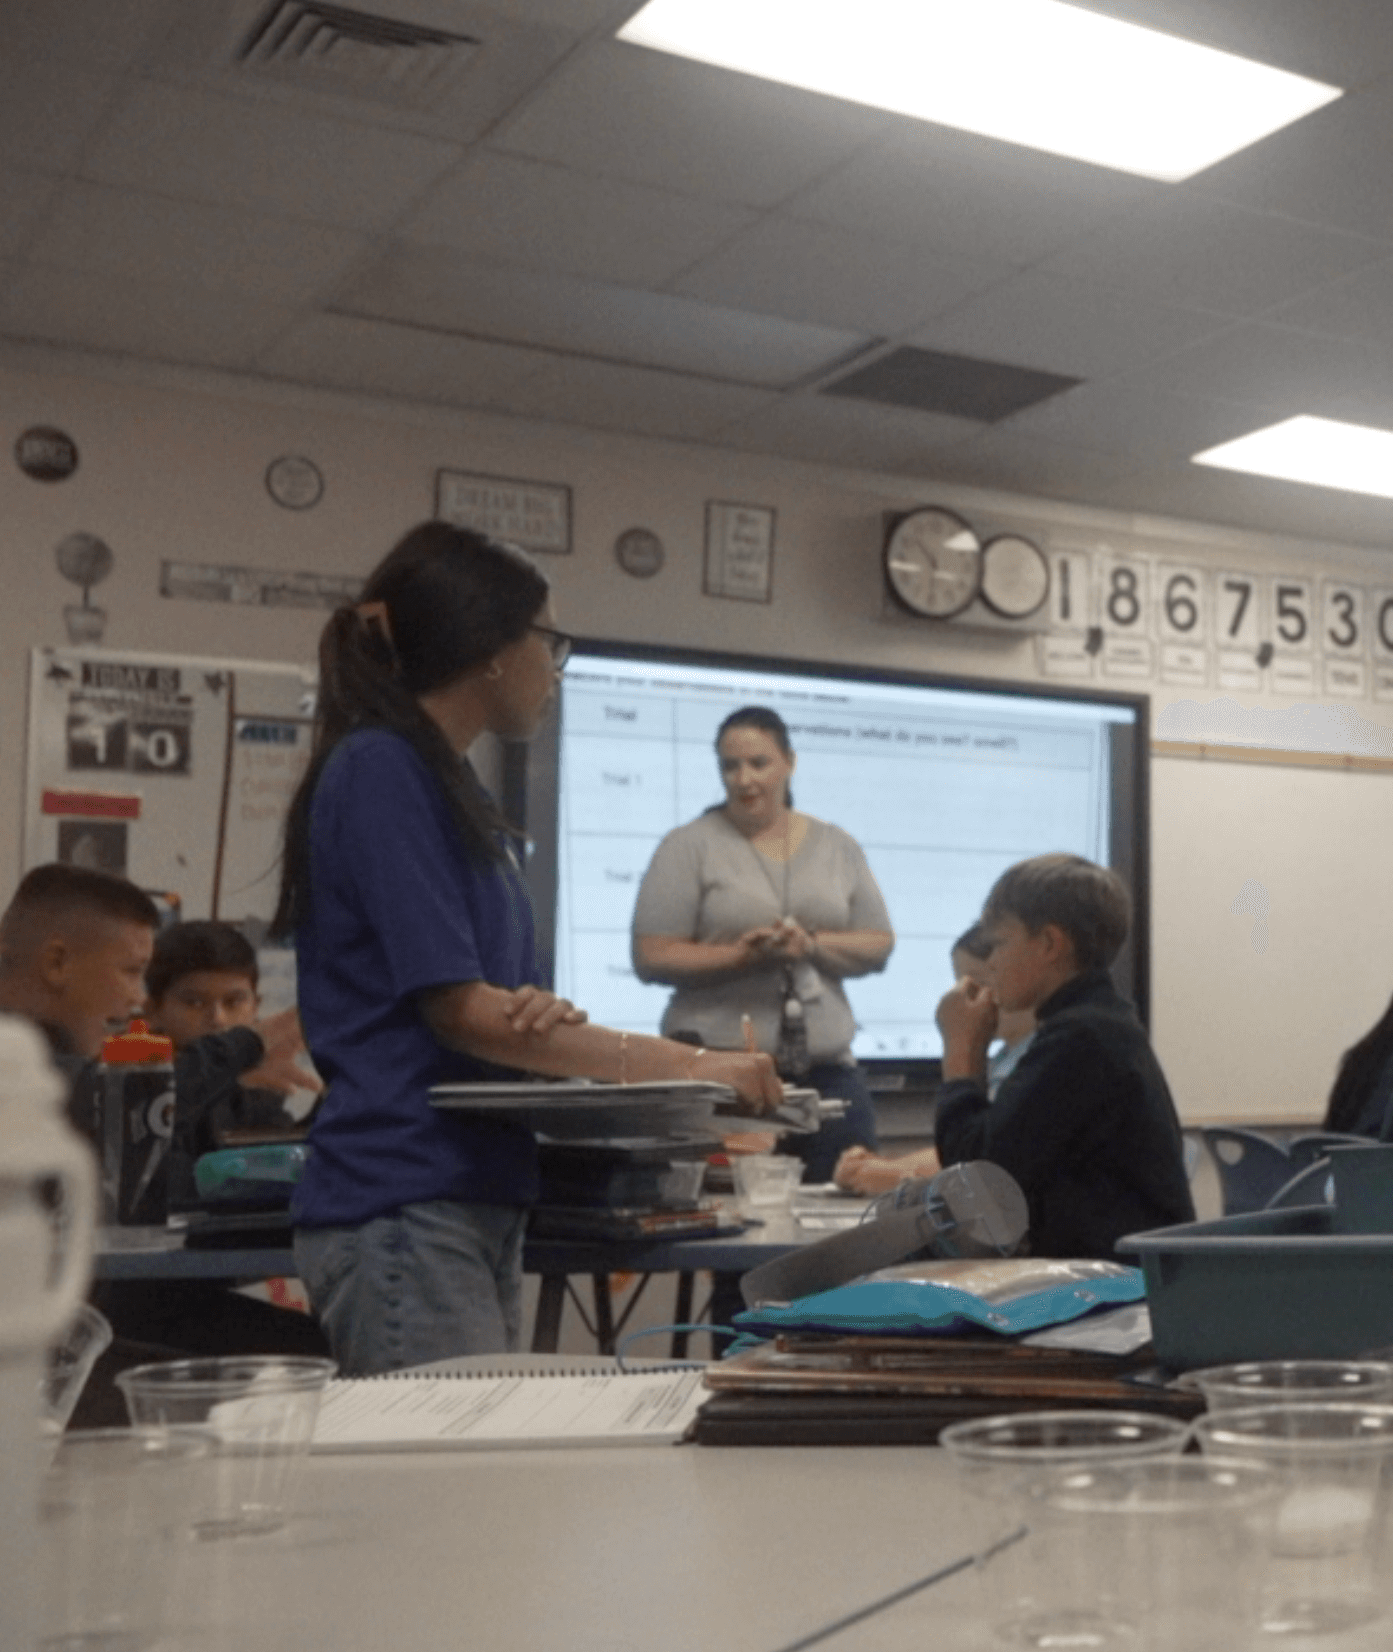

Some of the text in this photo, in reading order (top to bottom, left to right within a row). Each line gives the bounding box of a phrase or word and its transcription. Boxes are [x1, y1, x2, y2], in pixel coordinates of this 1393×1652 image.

[89, 664, 148, 688] TODAY
[604, 705, 636, 721] Trial
[786, 722, 852, 738] ervations
